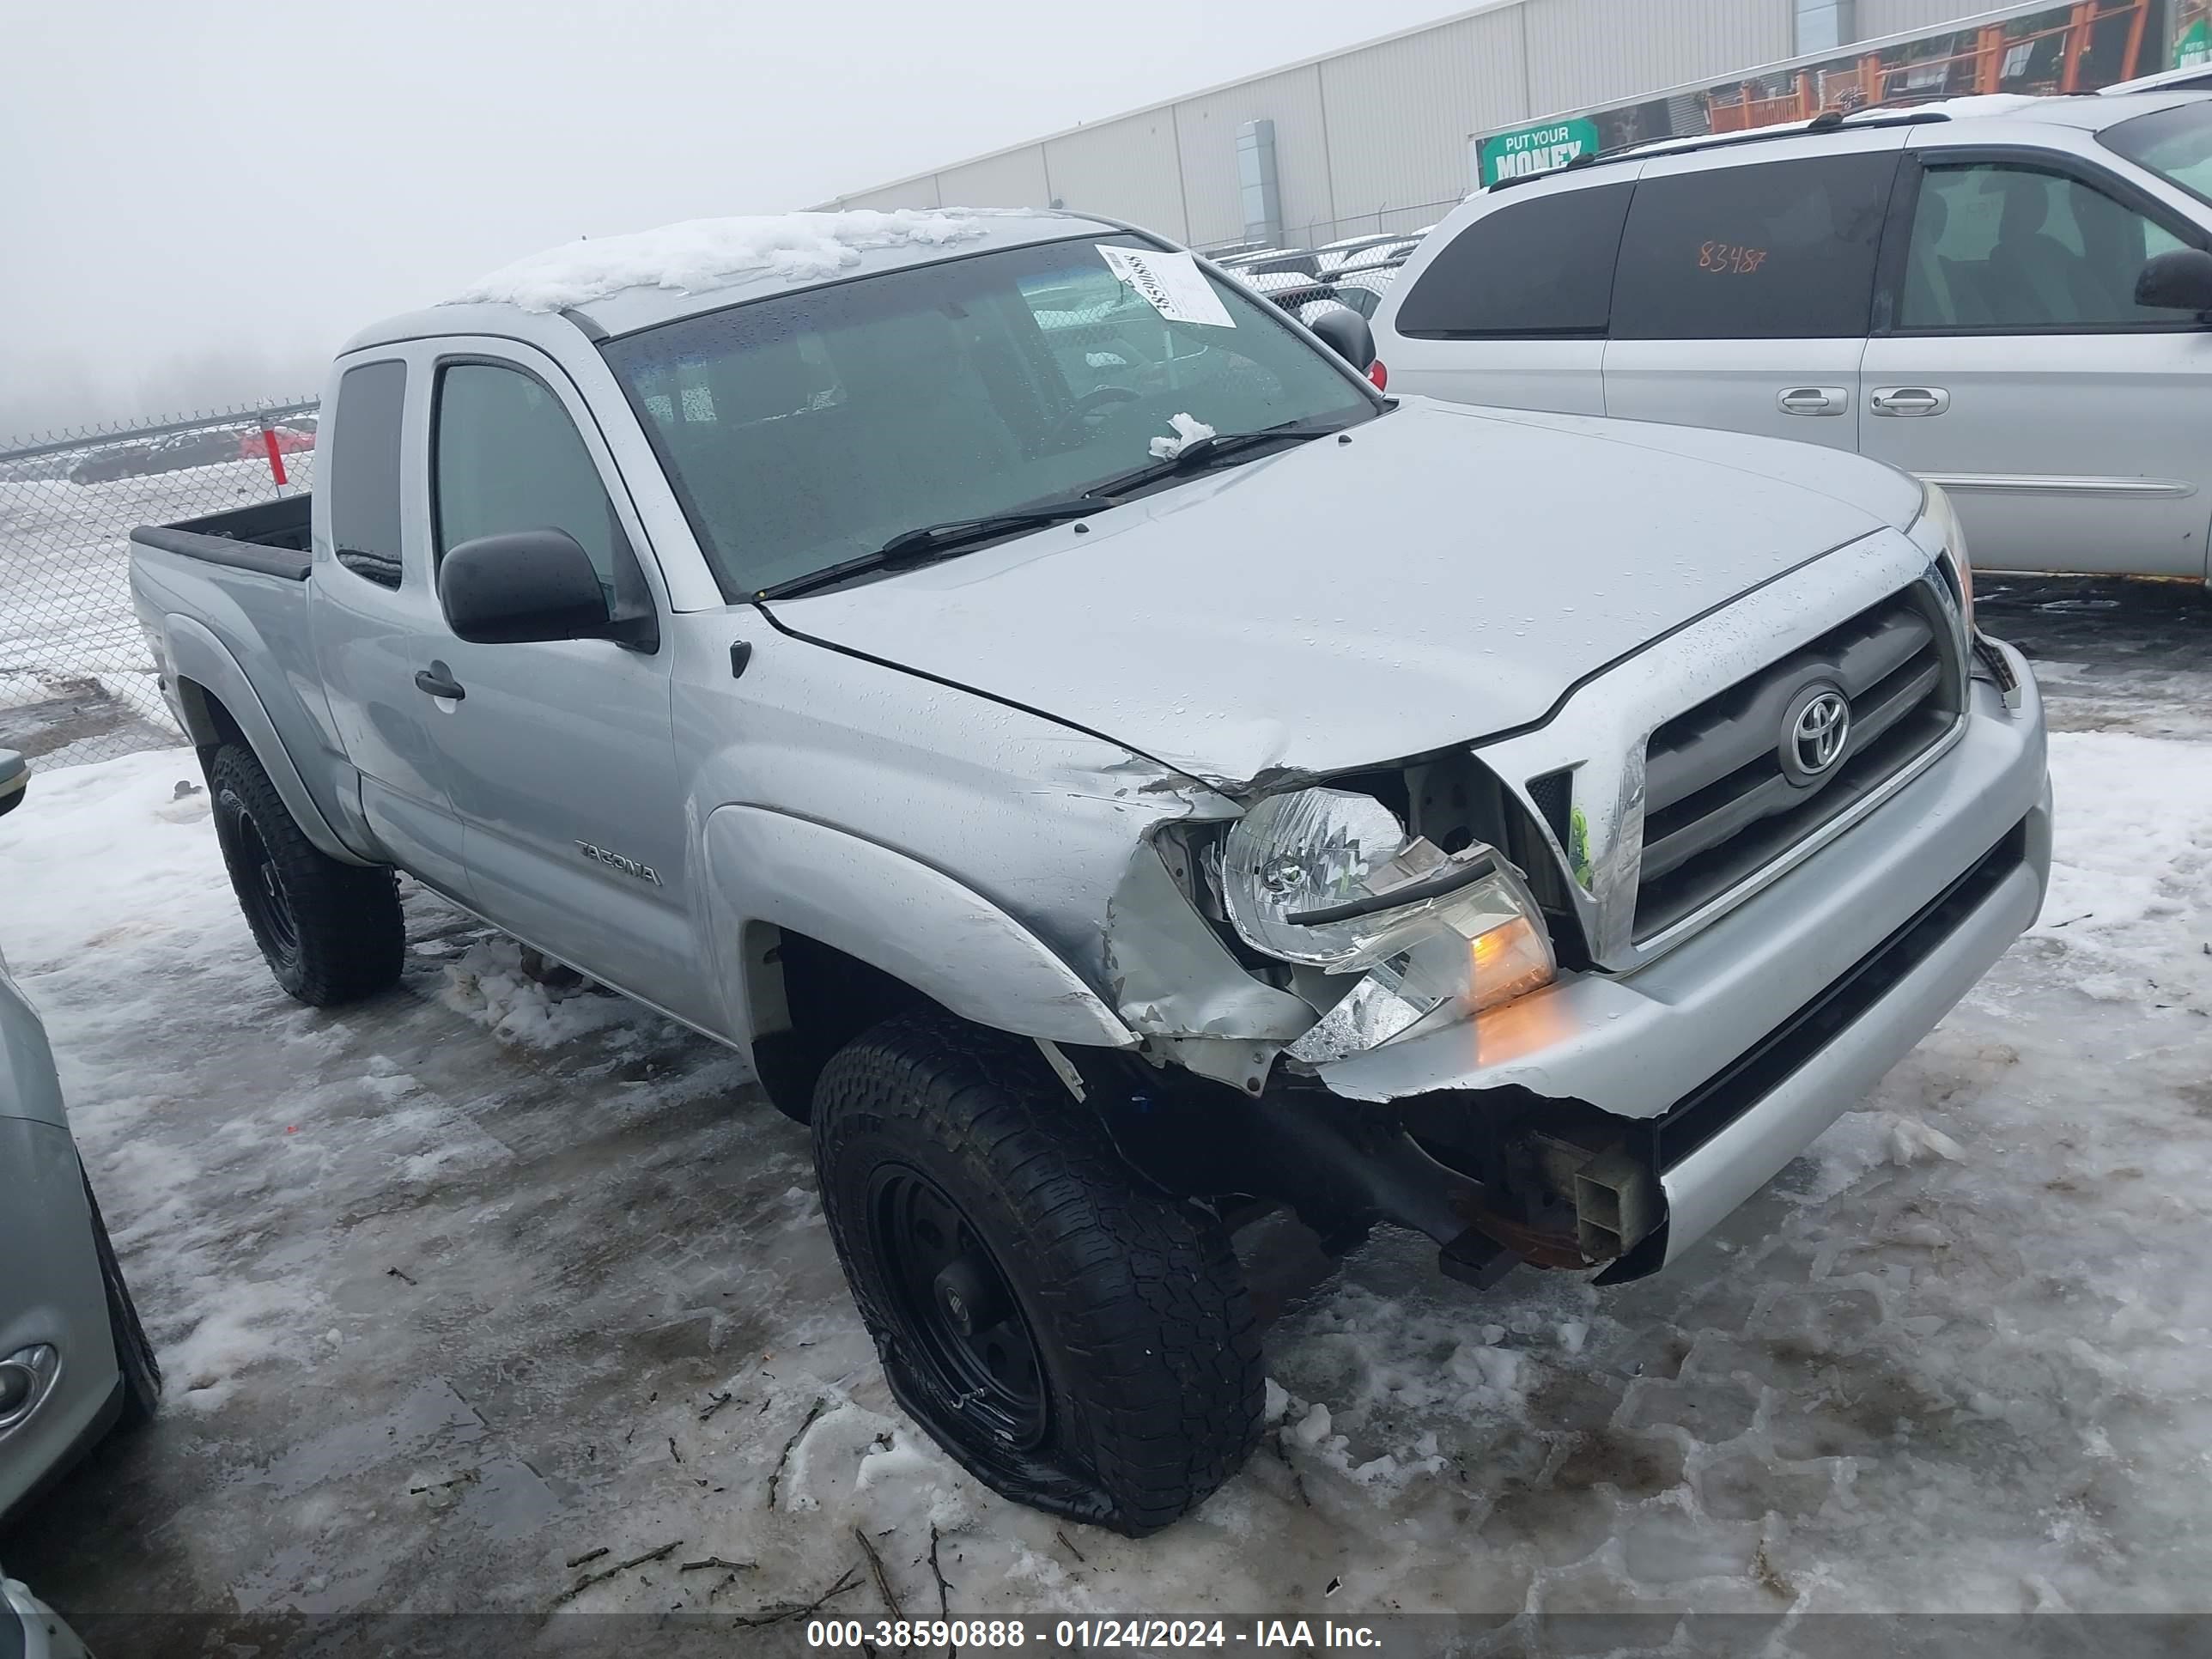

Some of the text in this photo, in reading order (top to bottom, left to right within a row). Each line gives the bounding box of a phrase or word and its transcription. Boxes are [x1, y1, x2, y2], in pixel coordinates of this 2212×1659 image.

[1505, 126, 1569, 151] PUT YOUR
[1496, 140, 1582, 181] MONEY
[1699, 240, 1766, 273] 83487
[1123, 254, 1175, 313] 38590888
[574, 839, 663, 887] TACOMA
